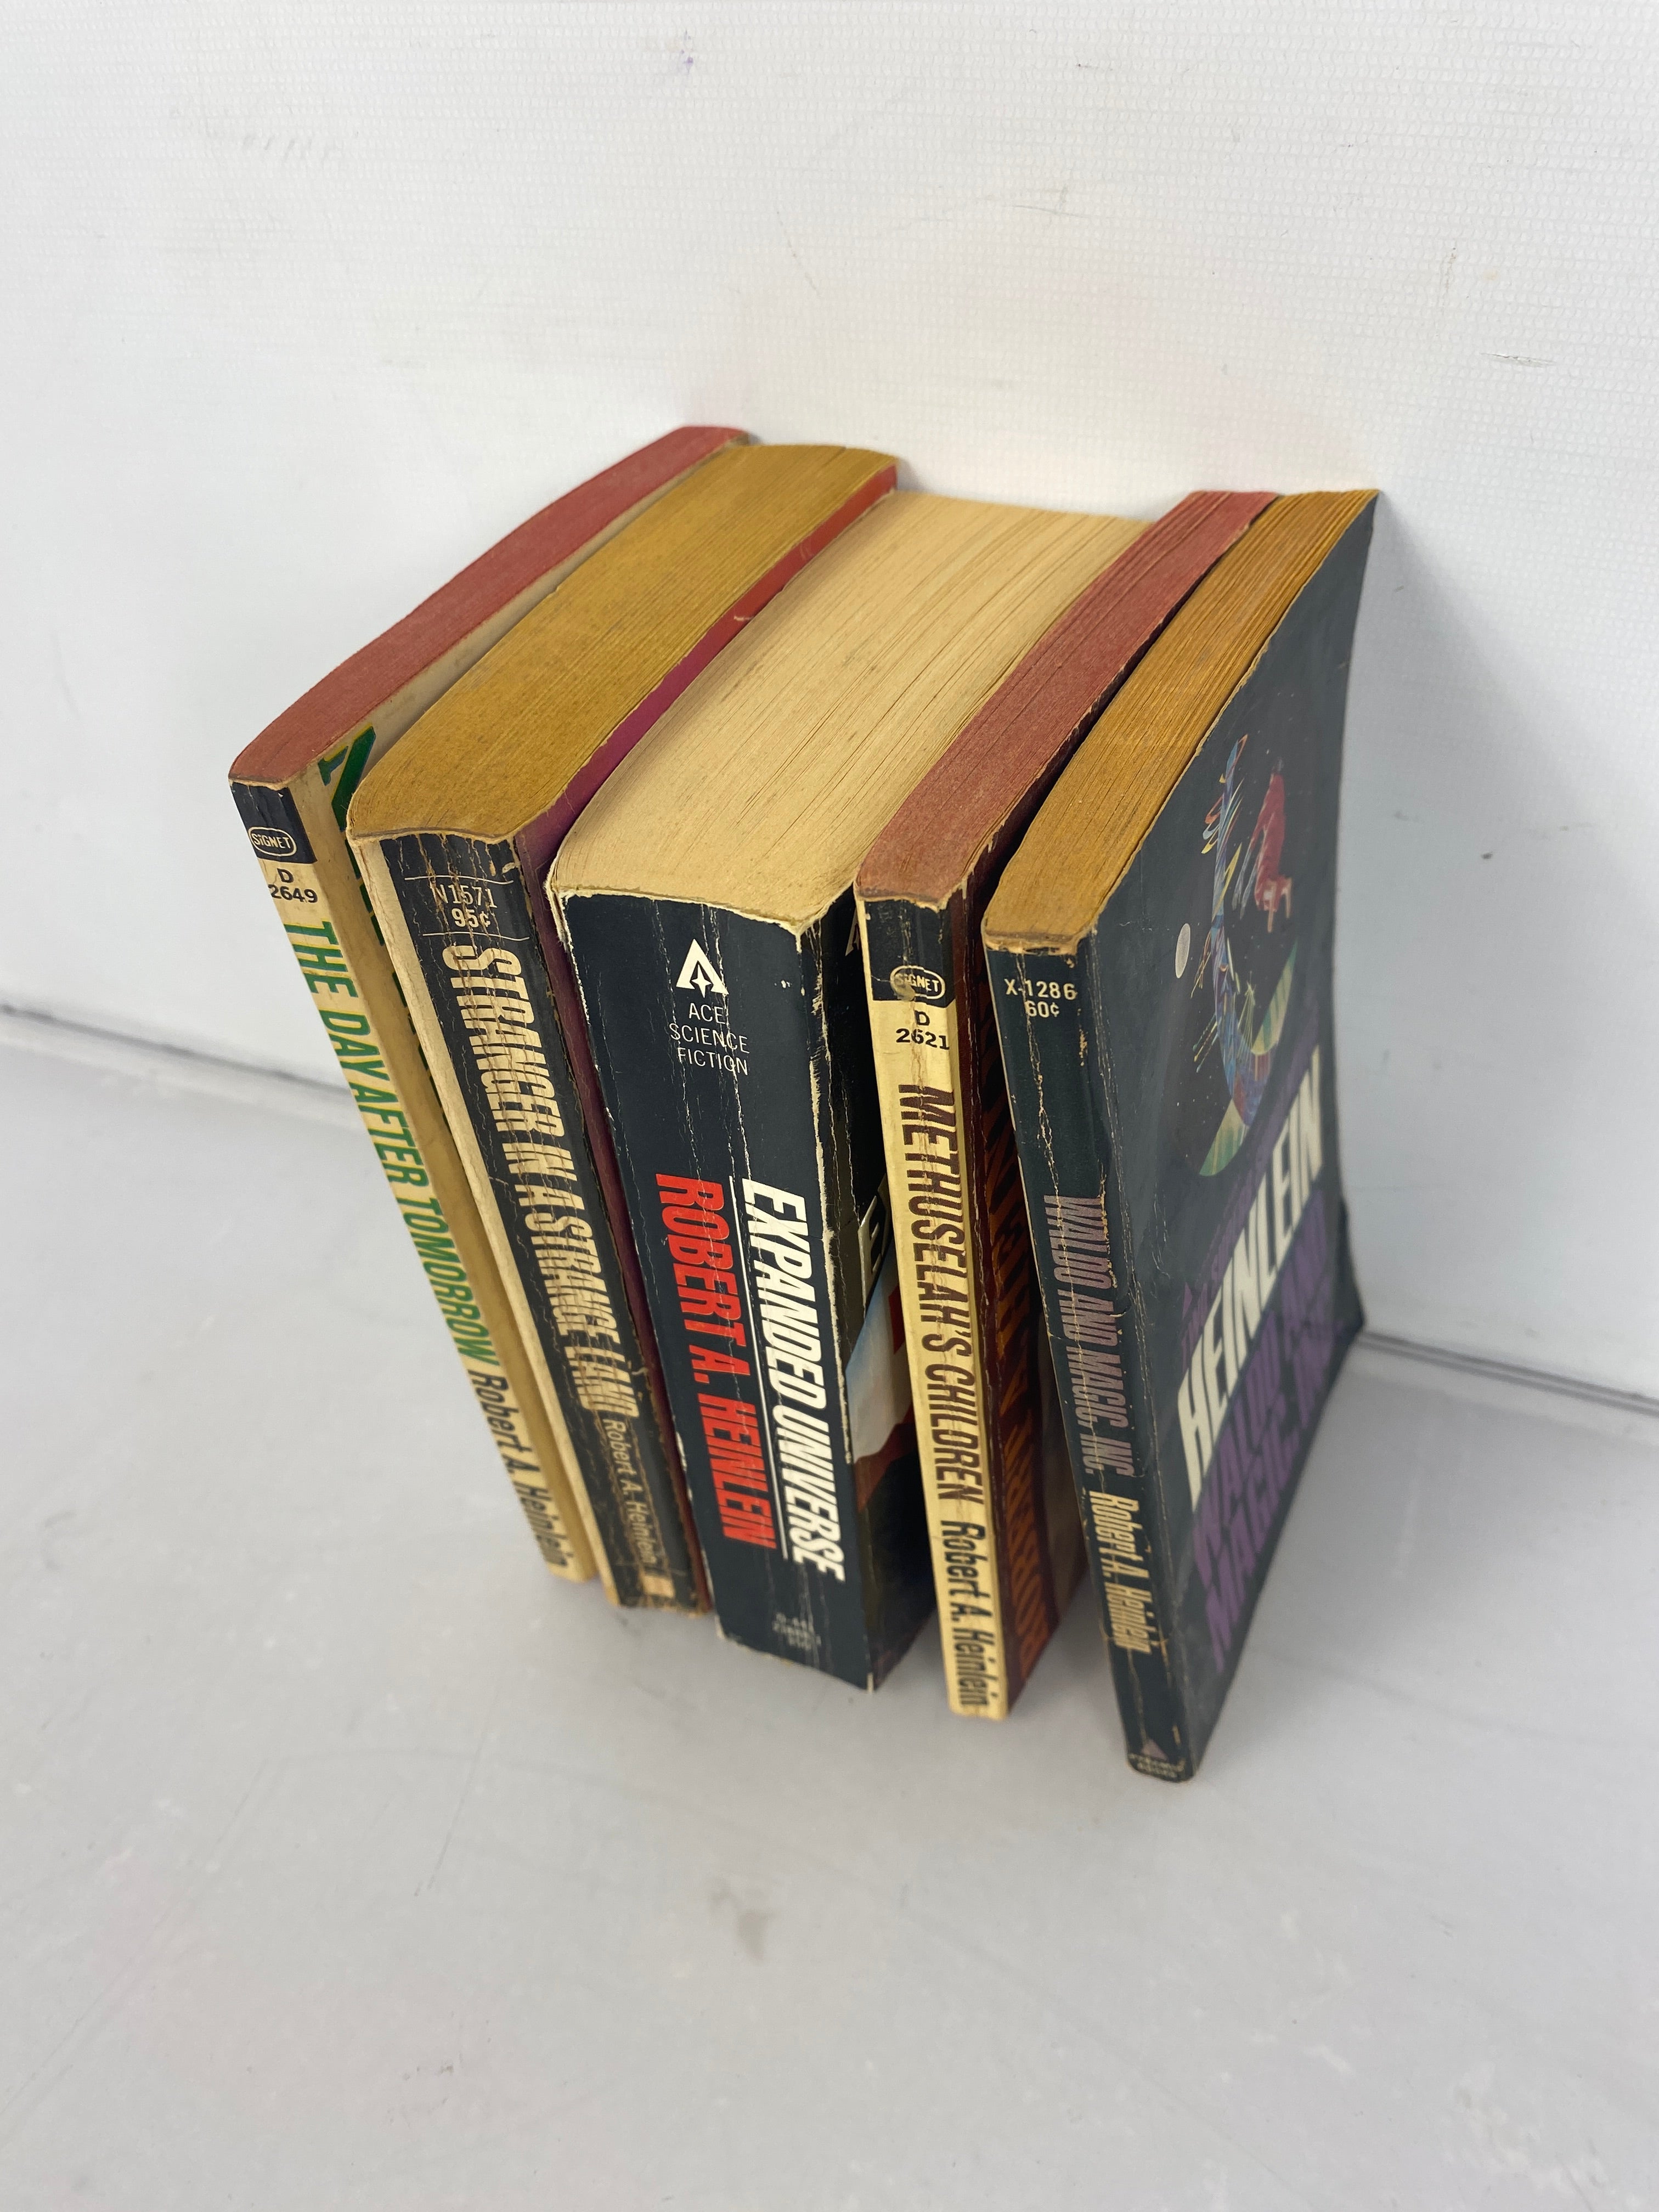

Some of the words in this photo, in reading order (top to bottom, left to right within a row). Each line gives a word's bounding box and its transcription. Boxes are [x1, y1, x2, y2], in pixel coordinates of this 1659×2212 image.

[269, 884, 318, 903] 2649
[276, 868, 293, 883] D
[430, 883, 498, 909] N1571
[451, 908, 491, 928] 95¢
[284, 920, 359, 997] THE
[1005, 978, 1077, 1000] X-1286
[442, 945, 565, 1137] STRANGER
[669, 1023, 750, 1054] SCIENCE
[689, 1002, 725, 1025] ACE
[896, 1029, 950, 1050] 2621
[916, 1011, 930, 1026] D
[1025, 1001, 1059, 1018] 60¢
[318, 1010, 390, 1081] DAY
[678, 1047, 748, 1076] FICTION
[350, 1081, 430, 1187] AFTER
[502, 1143, 577, 1181] IN
[515, 1184, 585, 1210] A
[898, 1084, 971, 1357] METHUSELAH'S
[656, 1173, 746, 1347] ROBERT
[1043, 1195, 1114, 1290] WALDO
[398, 1197, 499, 1366] TOMORROW
[524, 1212, 620, 1345] STRANGE
[741, 1177, 827, 1408] EXPANDED
[1178, 1044, 1323, 1513] HEINLEIN
[1059, 1291, 1119, 1347] AND
[565, 1346, 640, 1418] LAND
[688, 1345, 750, 1384] A.
[467, 1370, 533, 1455] Robert
[924, 1361, 985, 1505] CHILDREN
[602, 1418, 635, 1477] Robert
[697, 1393, 777, 1549] HEINLEIN
[1080, 1430, 1133, 1476] INC.
[771, 1403, 846, 1582] UNIVERSE
[1088, 1489, 1141, 1557] Robert
[940, 1519, 990, 1600] Robert
[948, 1625, 994, 1708] Heinlein
